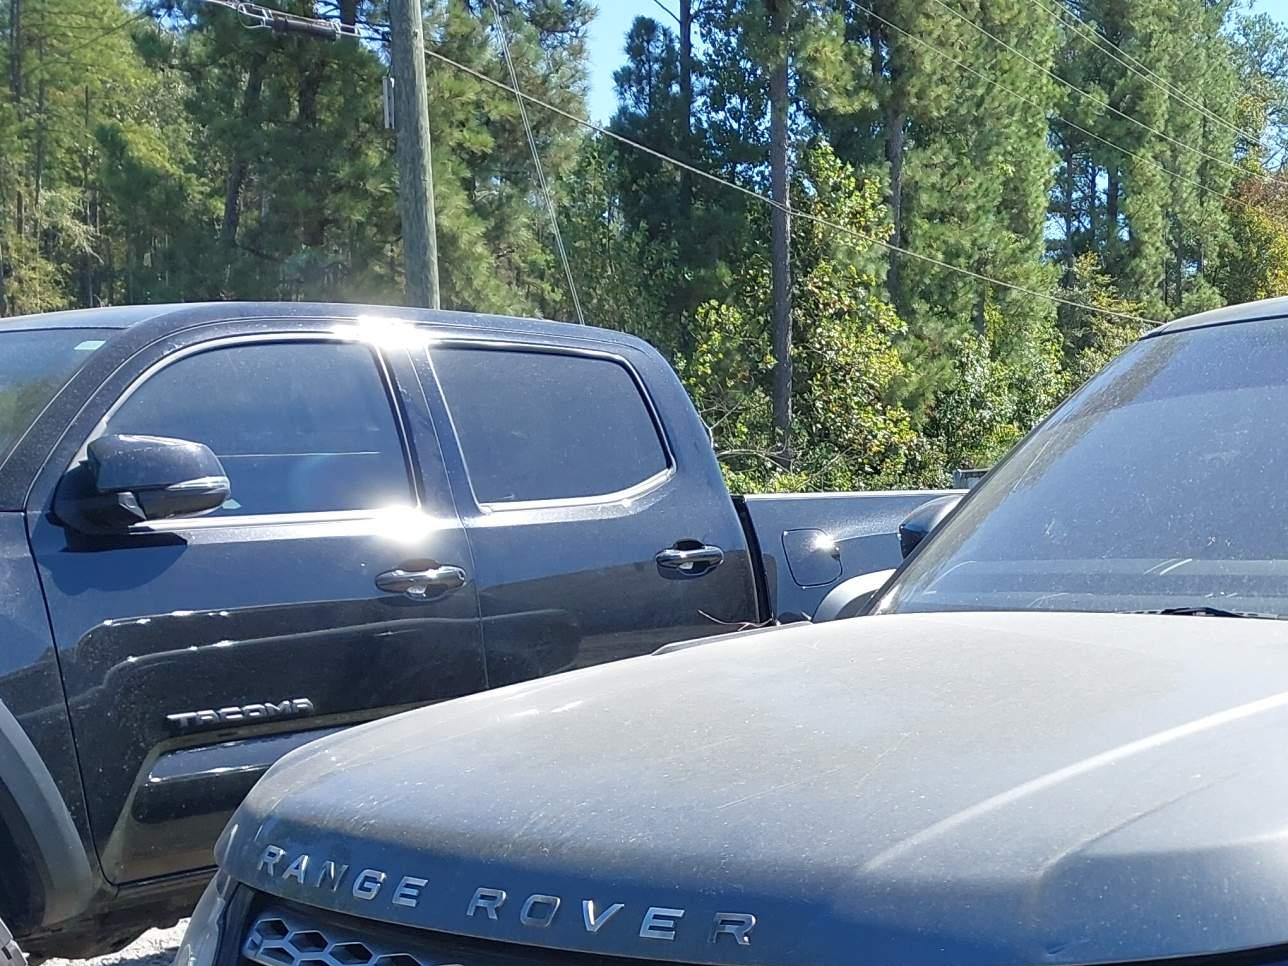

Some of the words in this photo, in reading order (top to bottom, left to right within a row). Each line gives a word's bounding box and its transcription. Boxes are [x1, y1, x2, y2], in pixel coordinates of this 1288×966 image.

[165, 697, 315, 728] TACOMA
[255, 844, 428, 907] RANGE
[465, 886, 757, 947] ROVER
